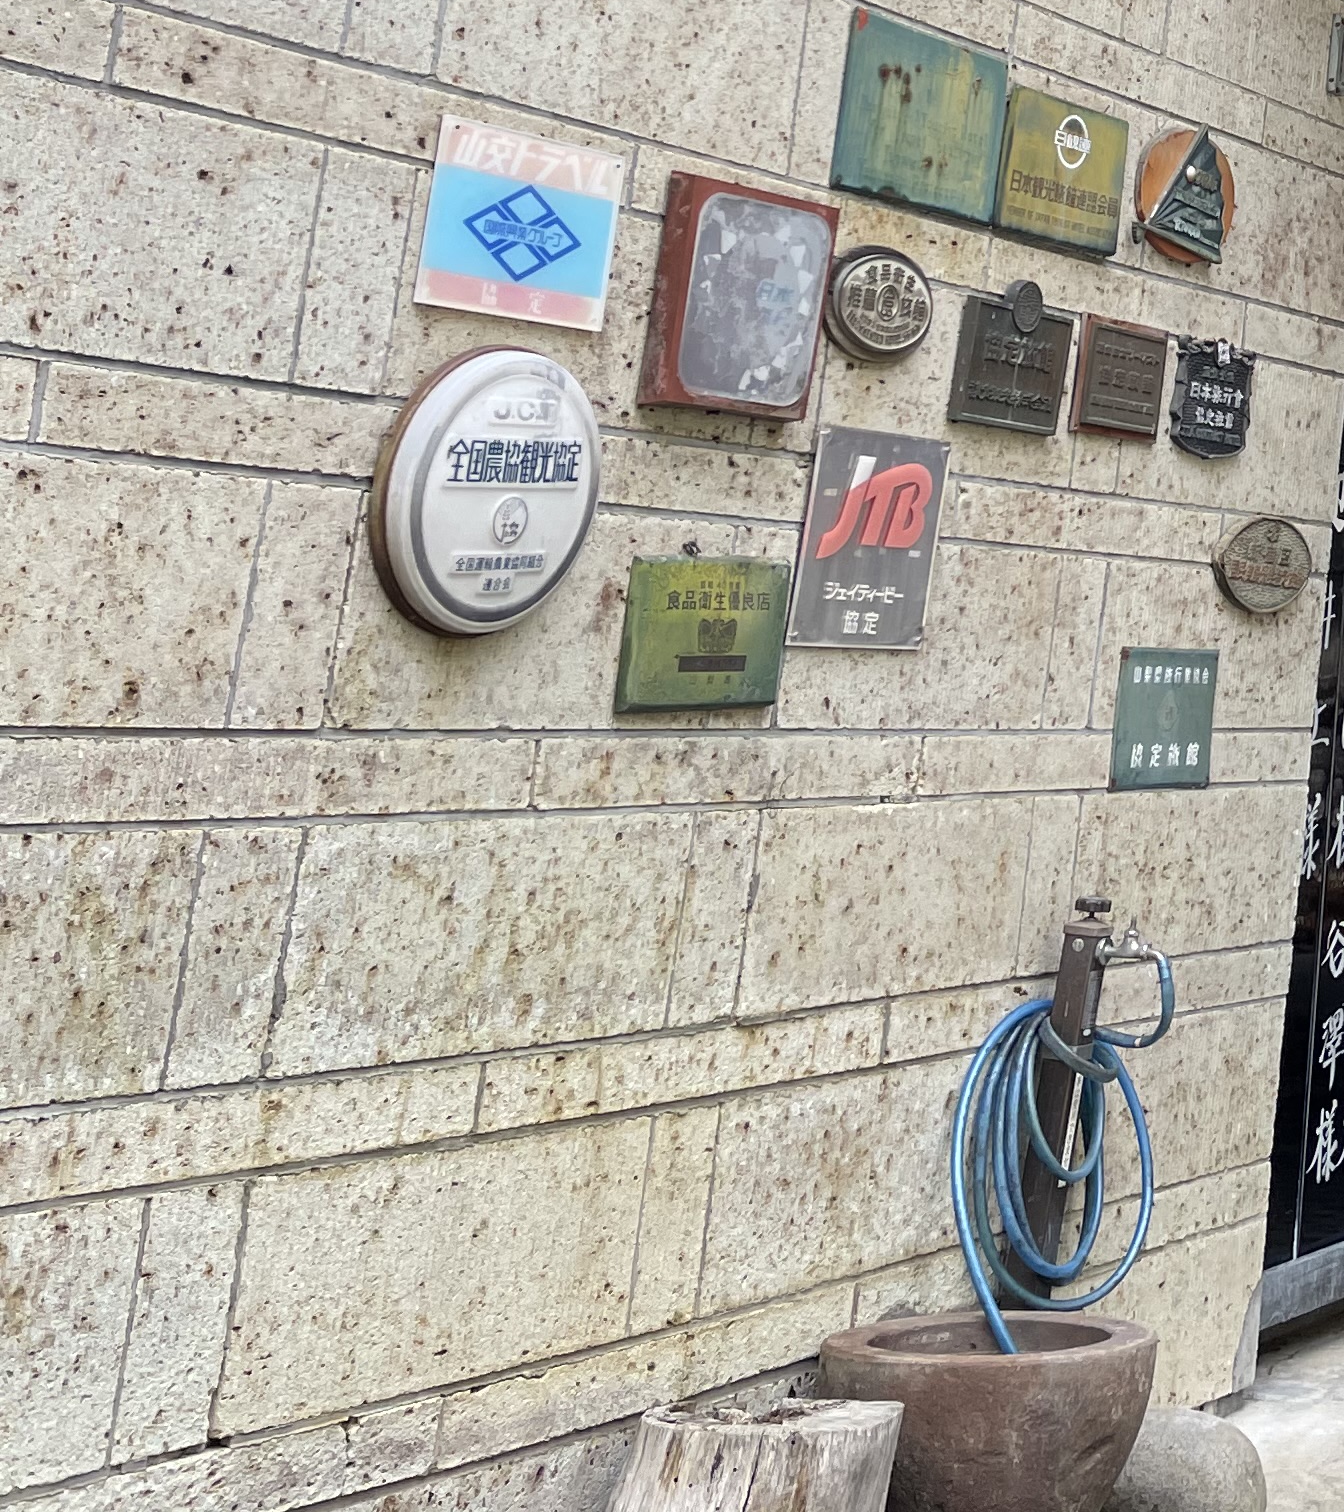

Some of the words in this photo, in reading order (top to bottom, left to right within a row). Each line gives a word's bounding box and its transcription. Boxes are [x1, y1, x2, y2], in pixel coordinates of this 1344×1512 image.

[452, 129, 609, 195] 山交トラベル
[447, 439, 582, 483] 全国農協観光協定
[816, 455, 934, 559] JTB
[666, 590, 771, 611] 食品衛生優良店
[823, 581, 905, 604] ジェイティービー
[843, 610, 879, 635] 協定
